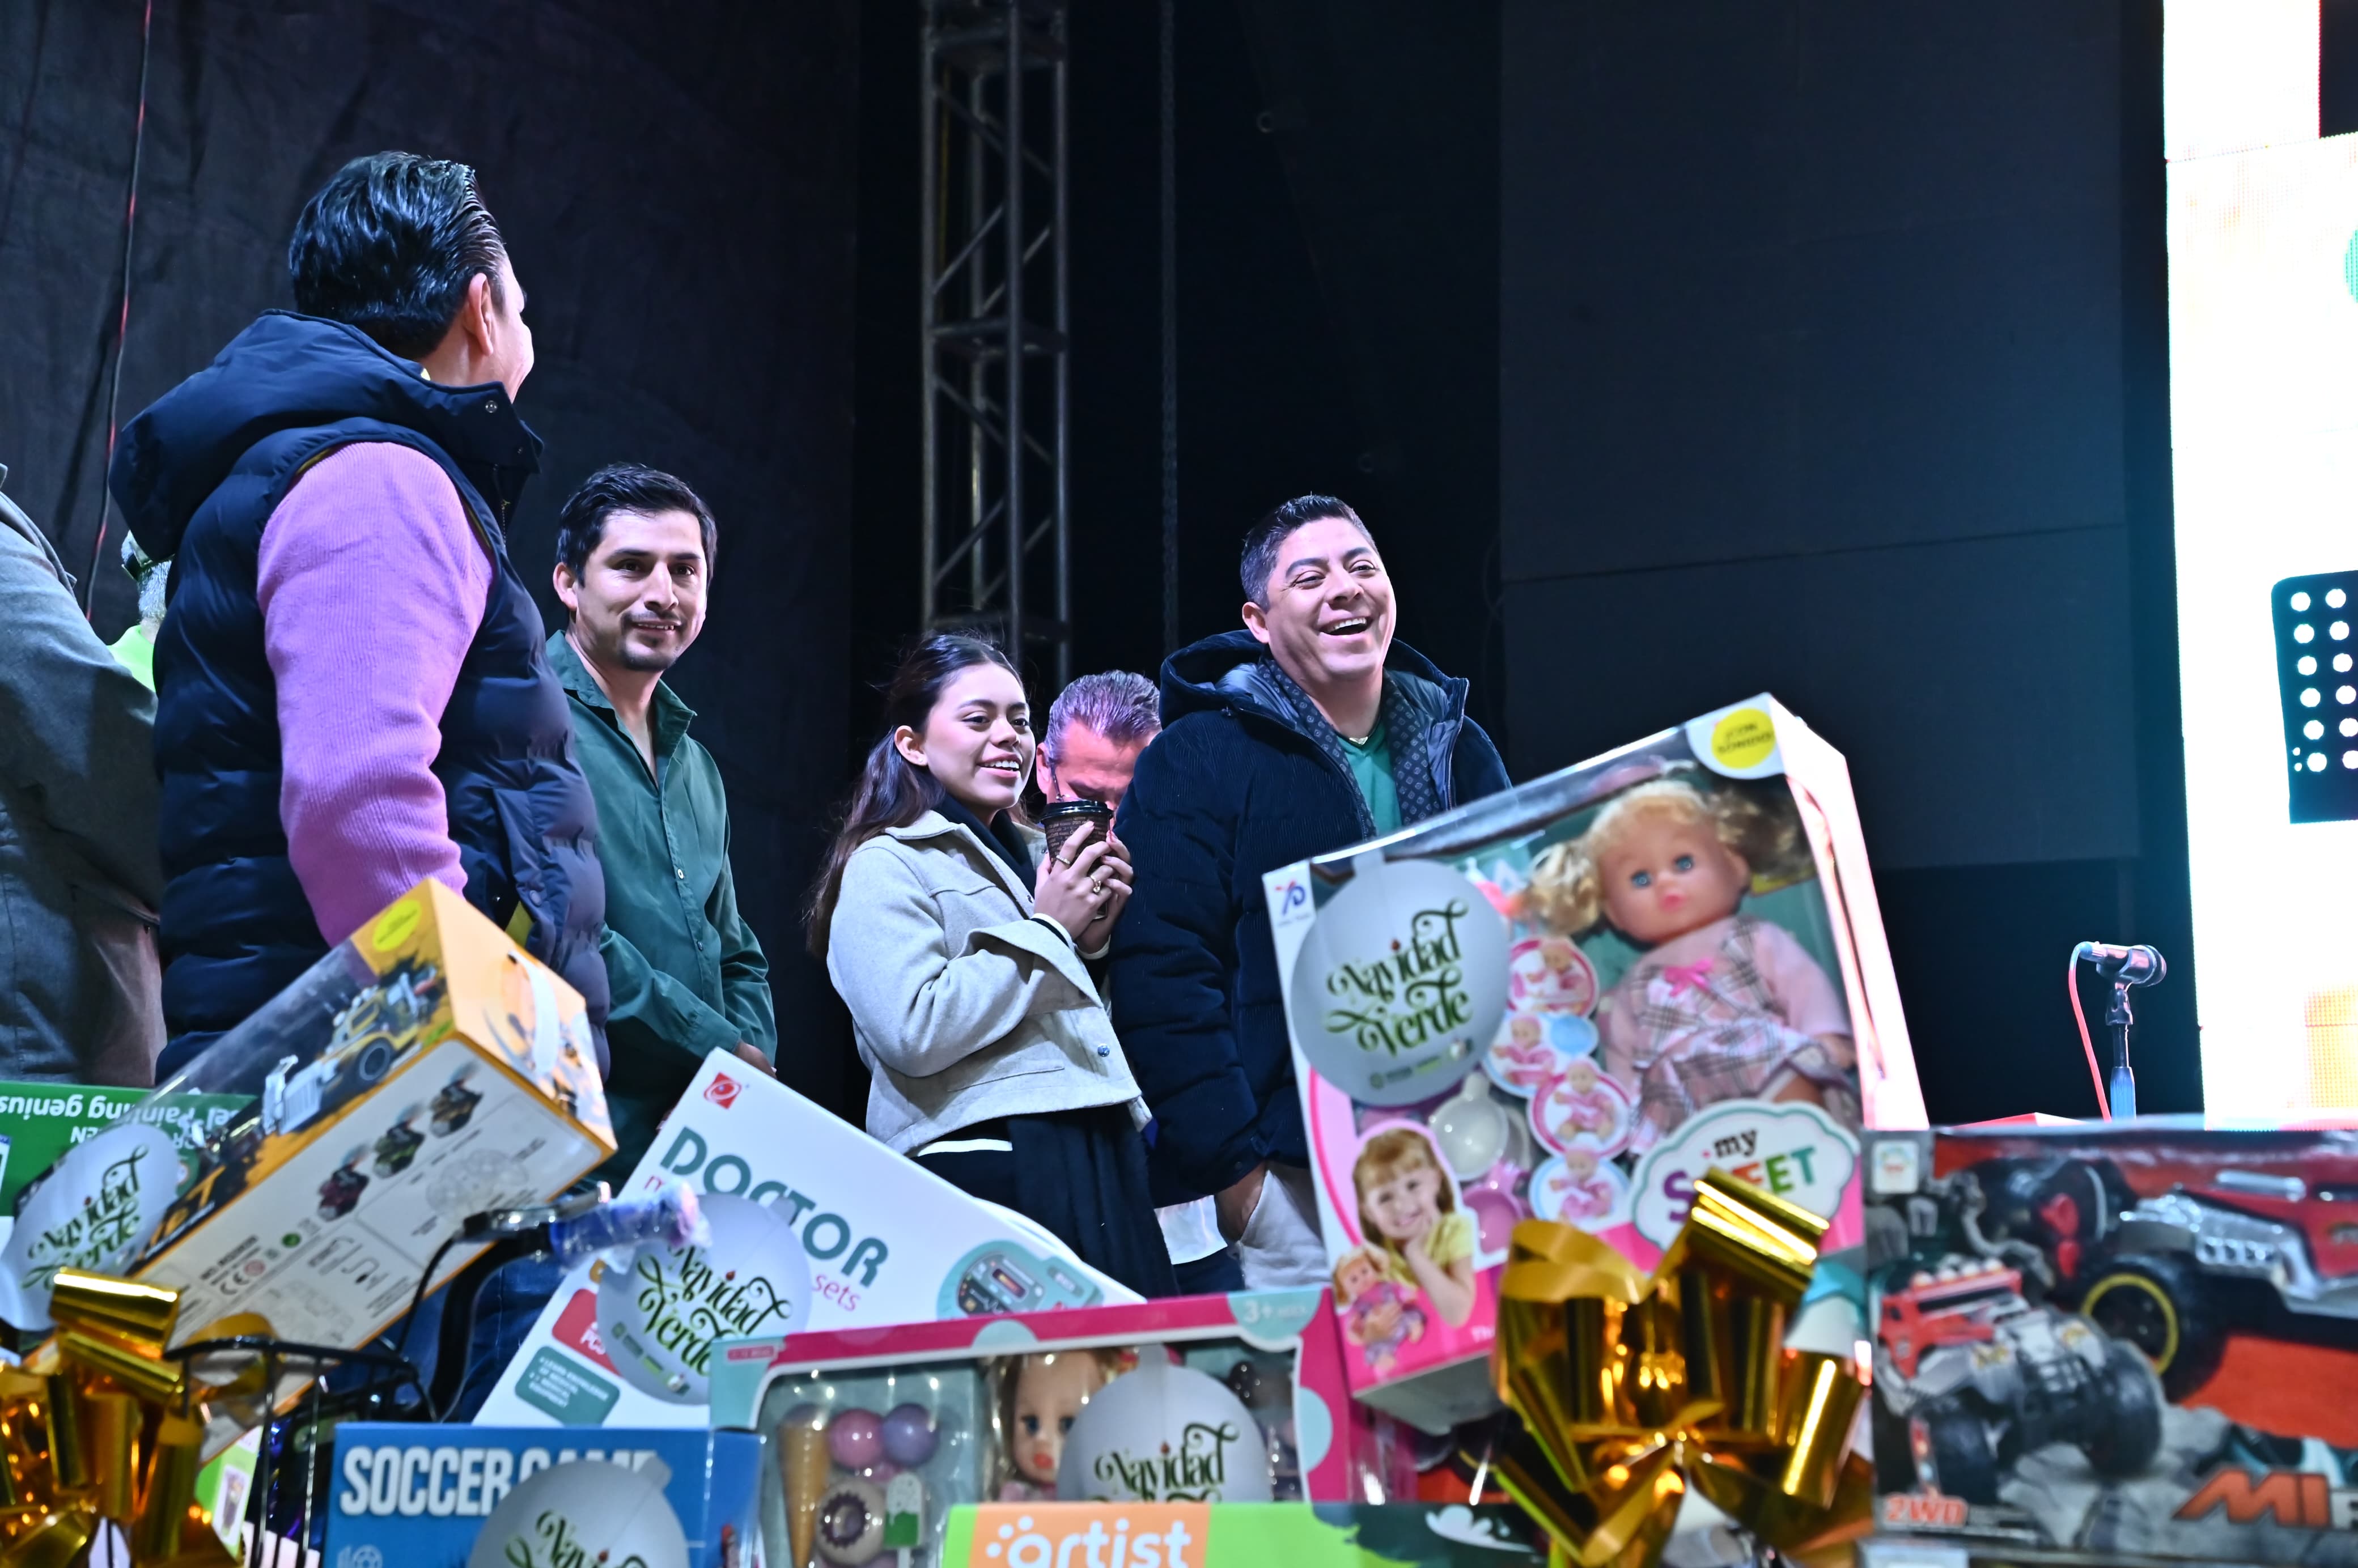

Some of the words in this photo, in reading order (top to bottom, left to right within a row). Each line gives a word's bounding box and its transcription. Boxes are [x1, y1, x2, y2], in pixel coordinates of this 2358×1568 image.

[1326, 897, 1470, 1005] Navidad
[1324, 967, 1471, 1059] Verde
[1714, 1128, 1758, 1158] my
[27, 1144, 150, 1259] Navidad
[1663, 1145, 1817, 1222] SEET
[667, 1245, 792, 1336] Navidad
[812, 1273, 861, 1312] sets
[340, 1446, 514, 1516] SOCCER
[1094, 1420, 1240, 1502] Navidad
[1007, 1517, 1192, 1568] artist
[1885, 1493, 1967, 1528] 2WD
